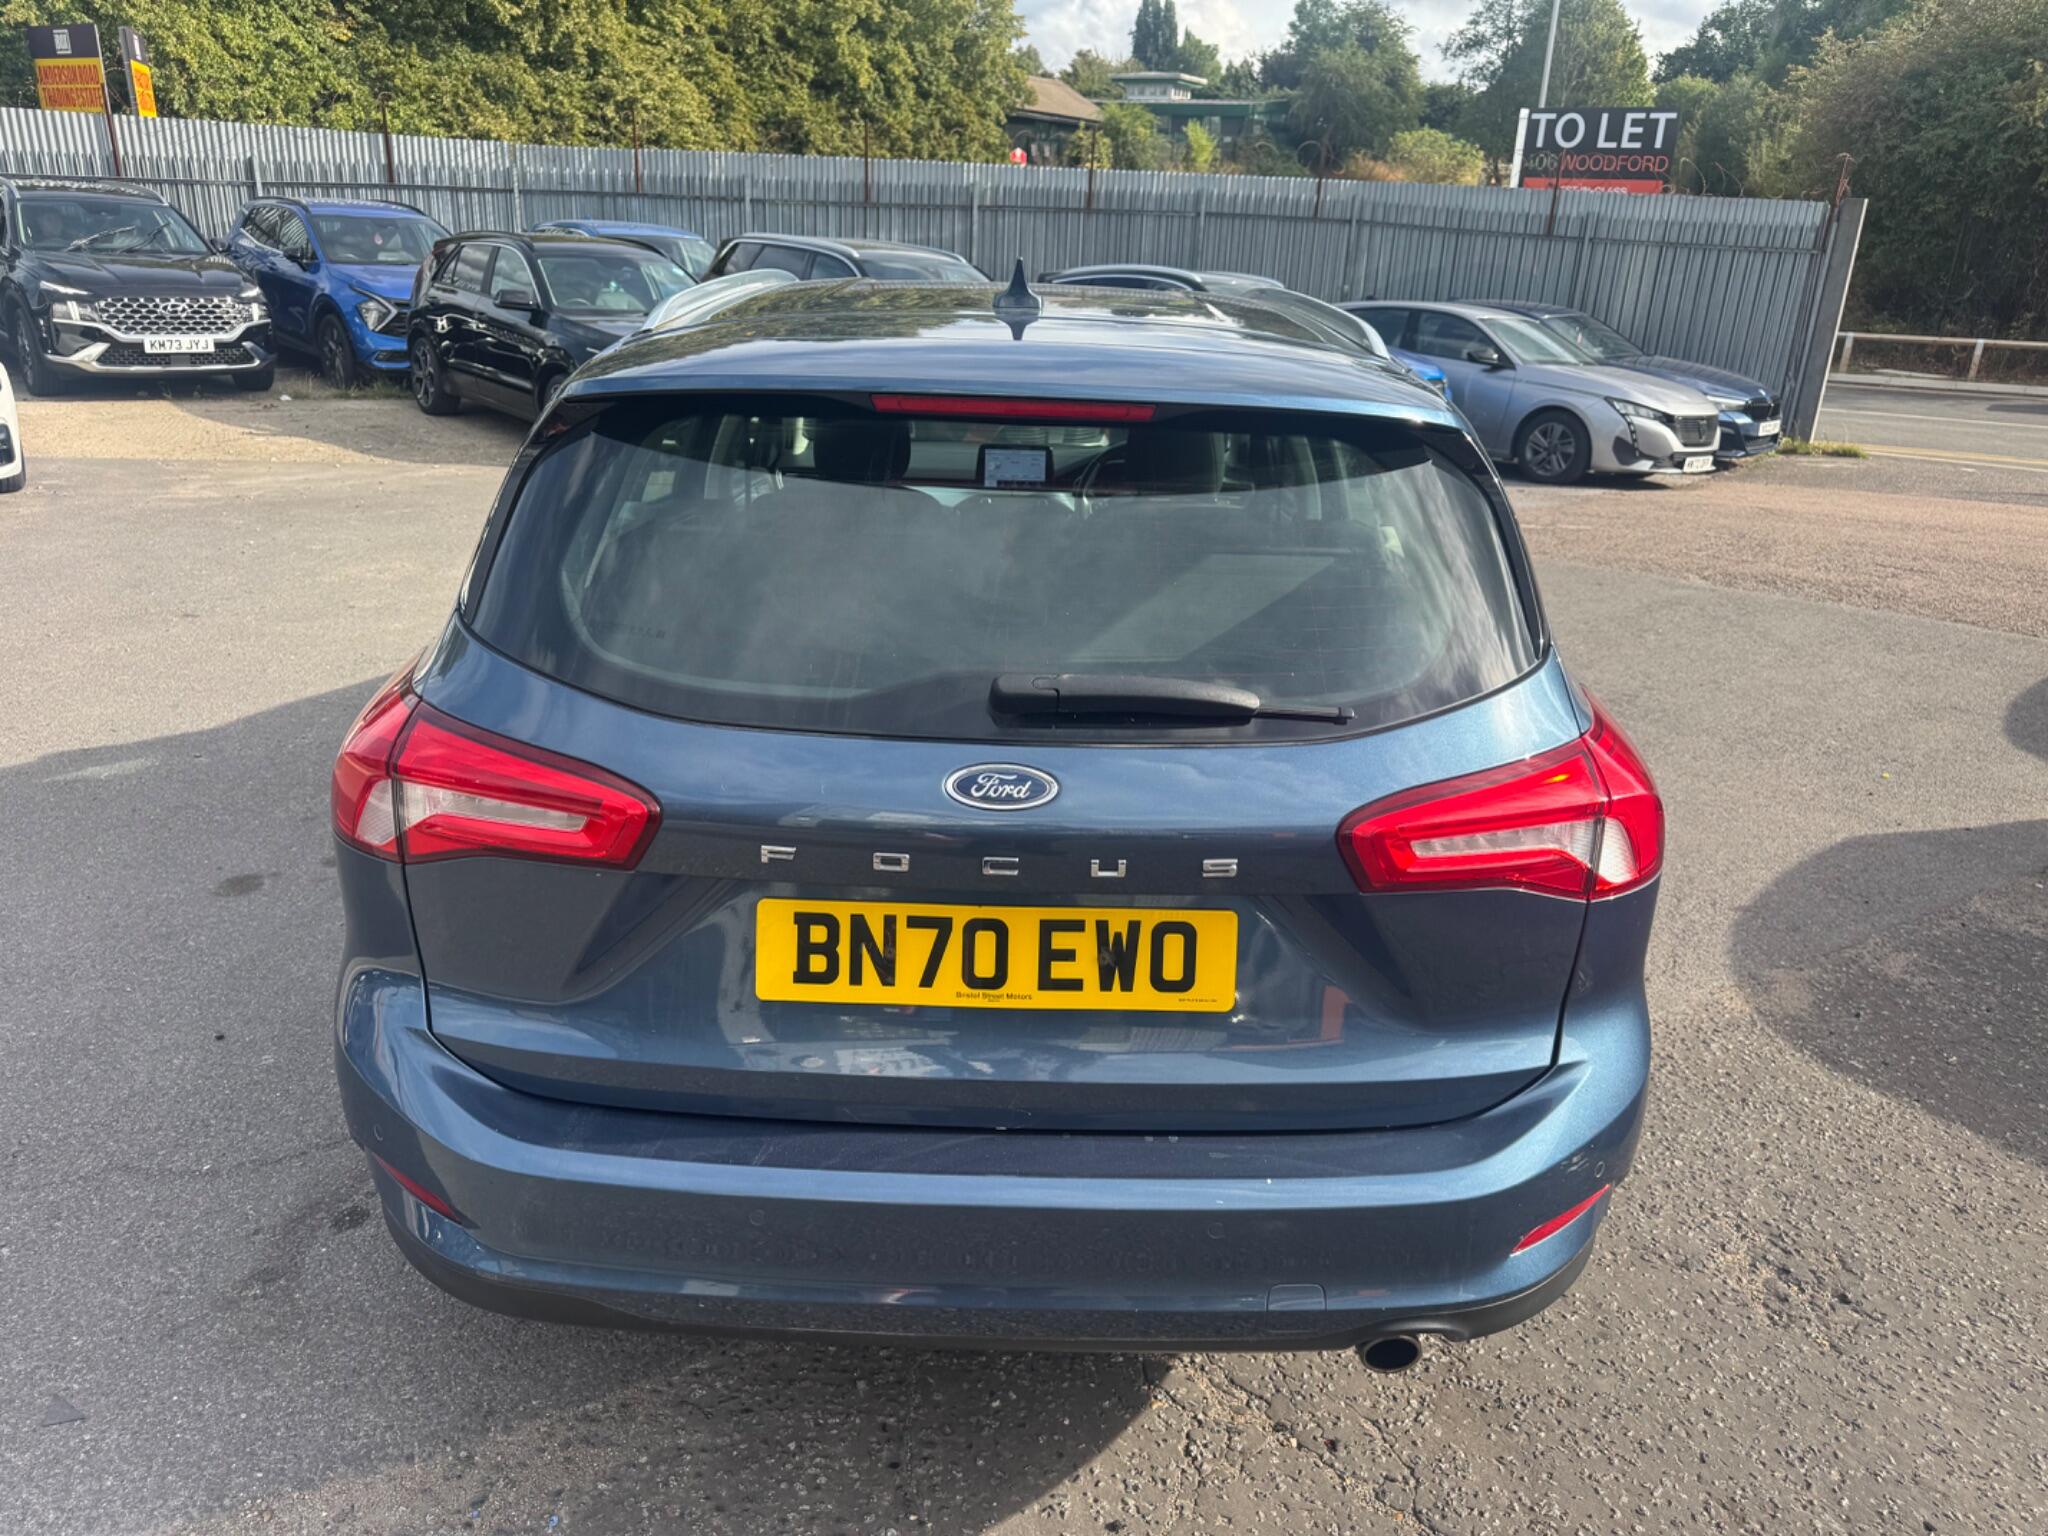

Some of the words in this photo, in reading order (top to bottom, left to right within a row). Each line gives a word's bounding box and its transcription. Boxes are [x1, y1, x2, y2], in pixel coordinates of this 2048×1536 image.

[77, 64, 99, 85] ROAD
[1531, 112, 1586, 149] TO
[1596, 112, 1677, 149] LET
[1561, 154, 1669, 172] WOODFORD
[185, 339, 209, 351] JYJ
[970, 772, 1032, 799] Ford
[761, 845, 1238, 878] FOCUS
[793, 911, 1009, 990] BN70
[1037, 919, 1197, 993] EWO
[956, 991, 980, 999] Bristol
[982, 992, 1004, 1001] Street
[1006, 992, 1033, 1001] Motors
